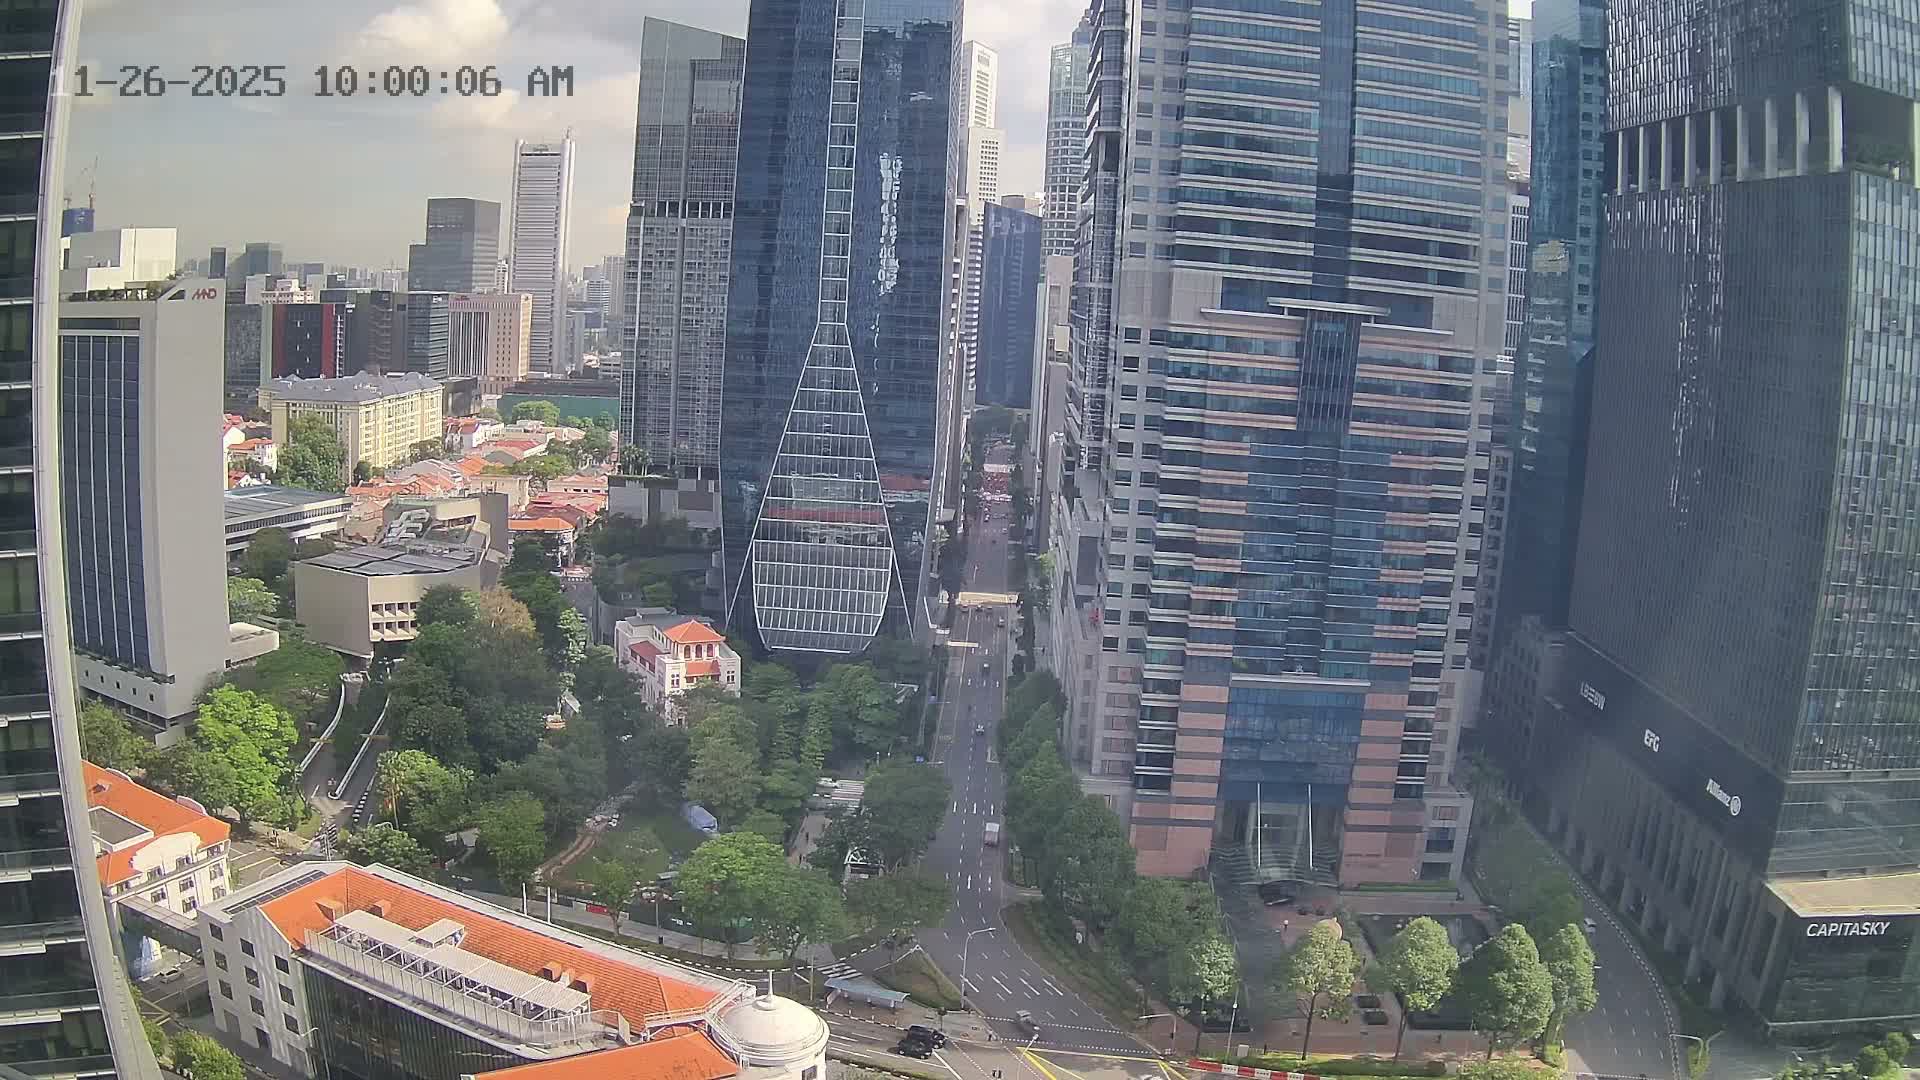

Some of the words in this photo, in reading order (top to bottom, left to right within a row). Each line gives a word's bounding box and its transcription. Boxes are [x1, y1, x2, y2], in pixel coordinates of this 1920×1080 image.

[1644, 729, 1660, 752] EFG
[1706, 778, 1731, 807] Allianz
[1806, 922, 1890, 937] CAPITASKY
